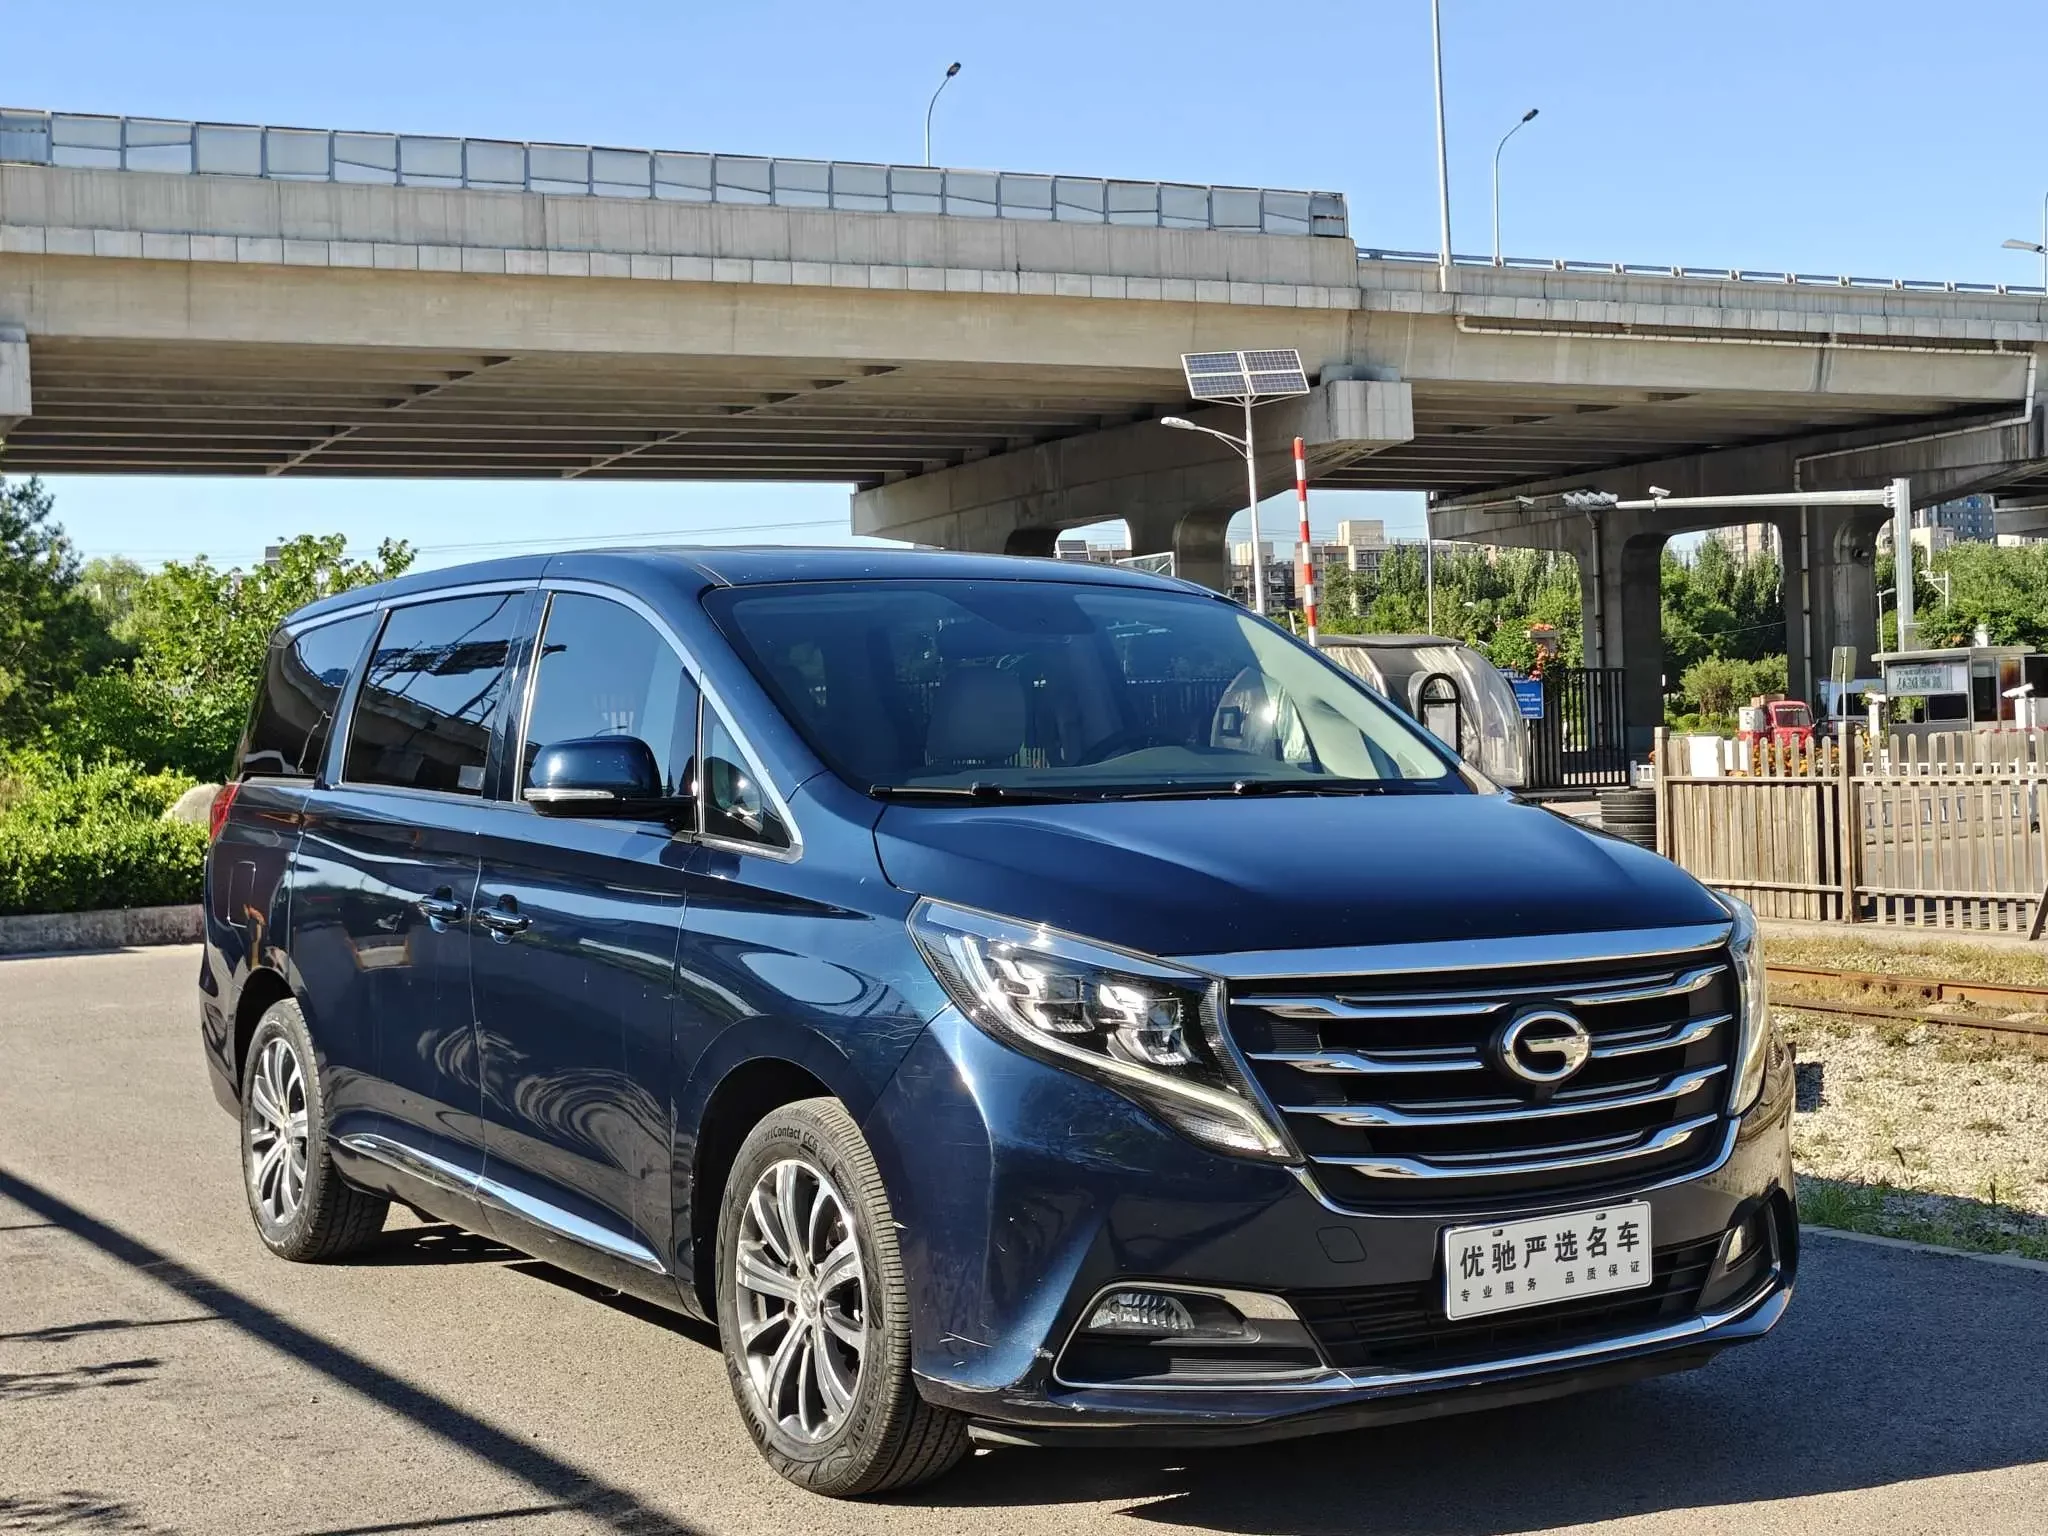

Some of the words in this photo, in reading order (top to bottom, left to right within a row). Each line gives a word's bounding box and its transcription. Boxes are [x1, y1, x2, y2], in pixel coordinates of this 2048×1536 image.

[1460, 1221, 1640, 1280] 优驰严选名车
[1460, 1278, 1537, 1303] 专业服务
[1565, 1260, 1640, 1285] 品质保证
